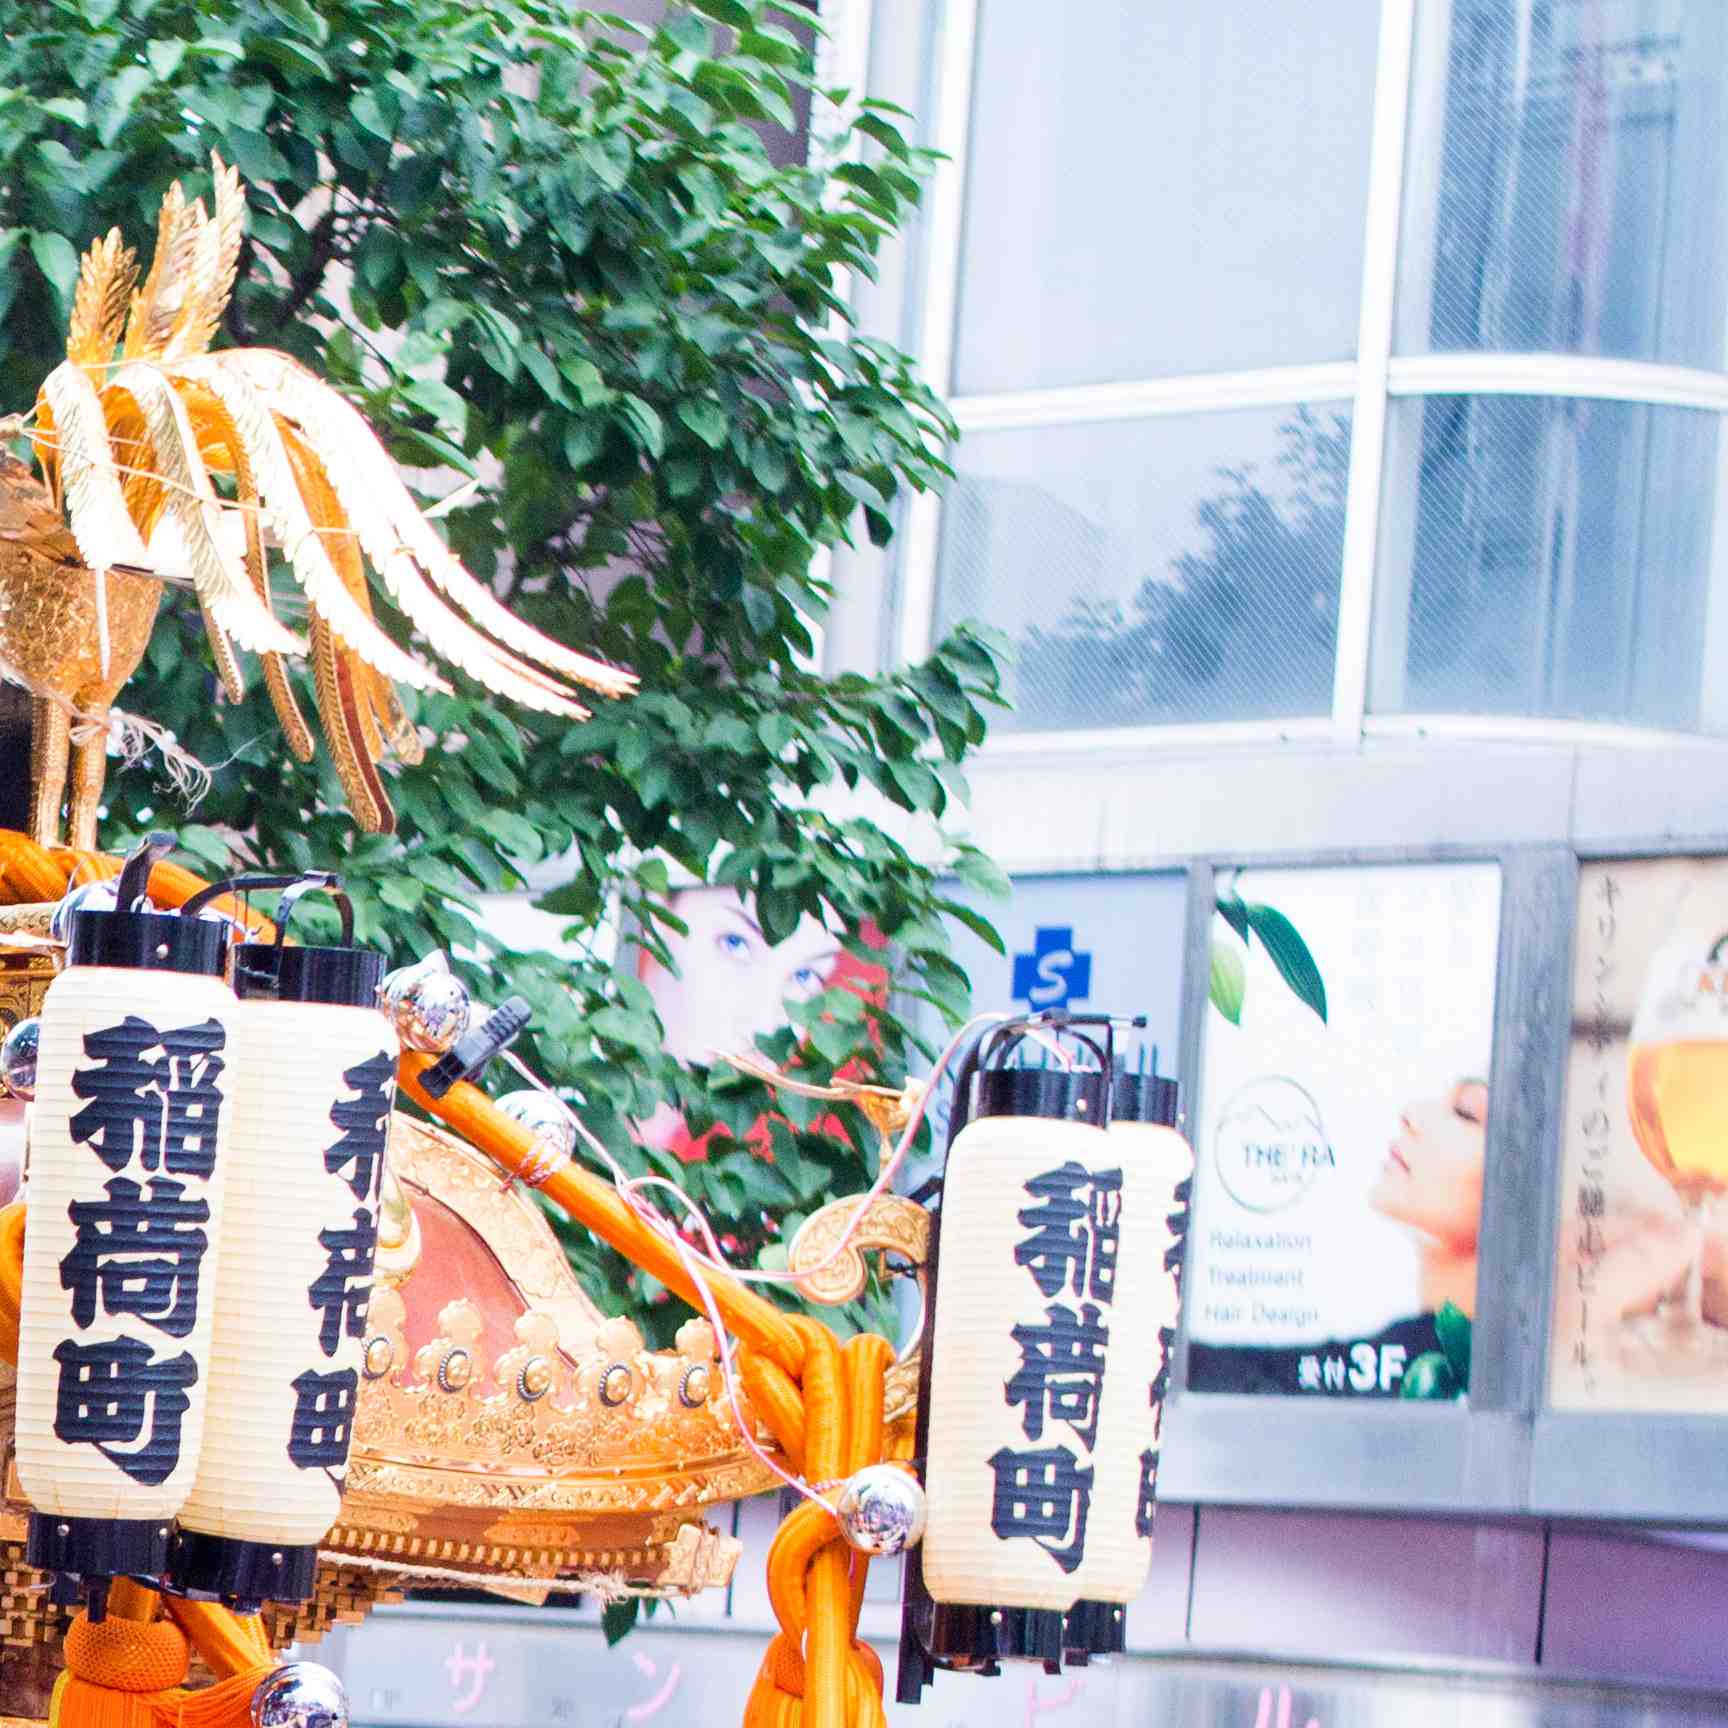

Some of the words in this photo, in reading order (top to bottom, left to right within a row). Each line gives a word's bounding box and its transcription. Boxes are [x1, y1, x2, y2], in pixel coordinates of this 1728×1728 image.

[52, 1015, 228, 1486] 稲荷町
[985, 1160, 1124, 1576] 稲荷町
